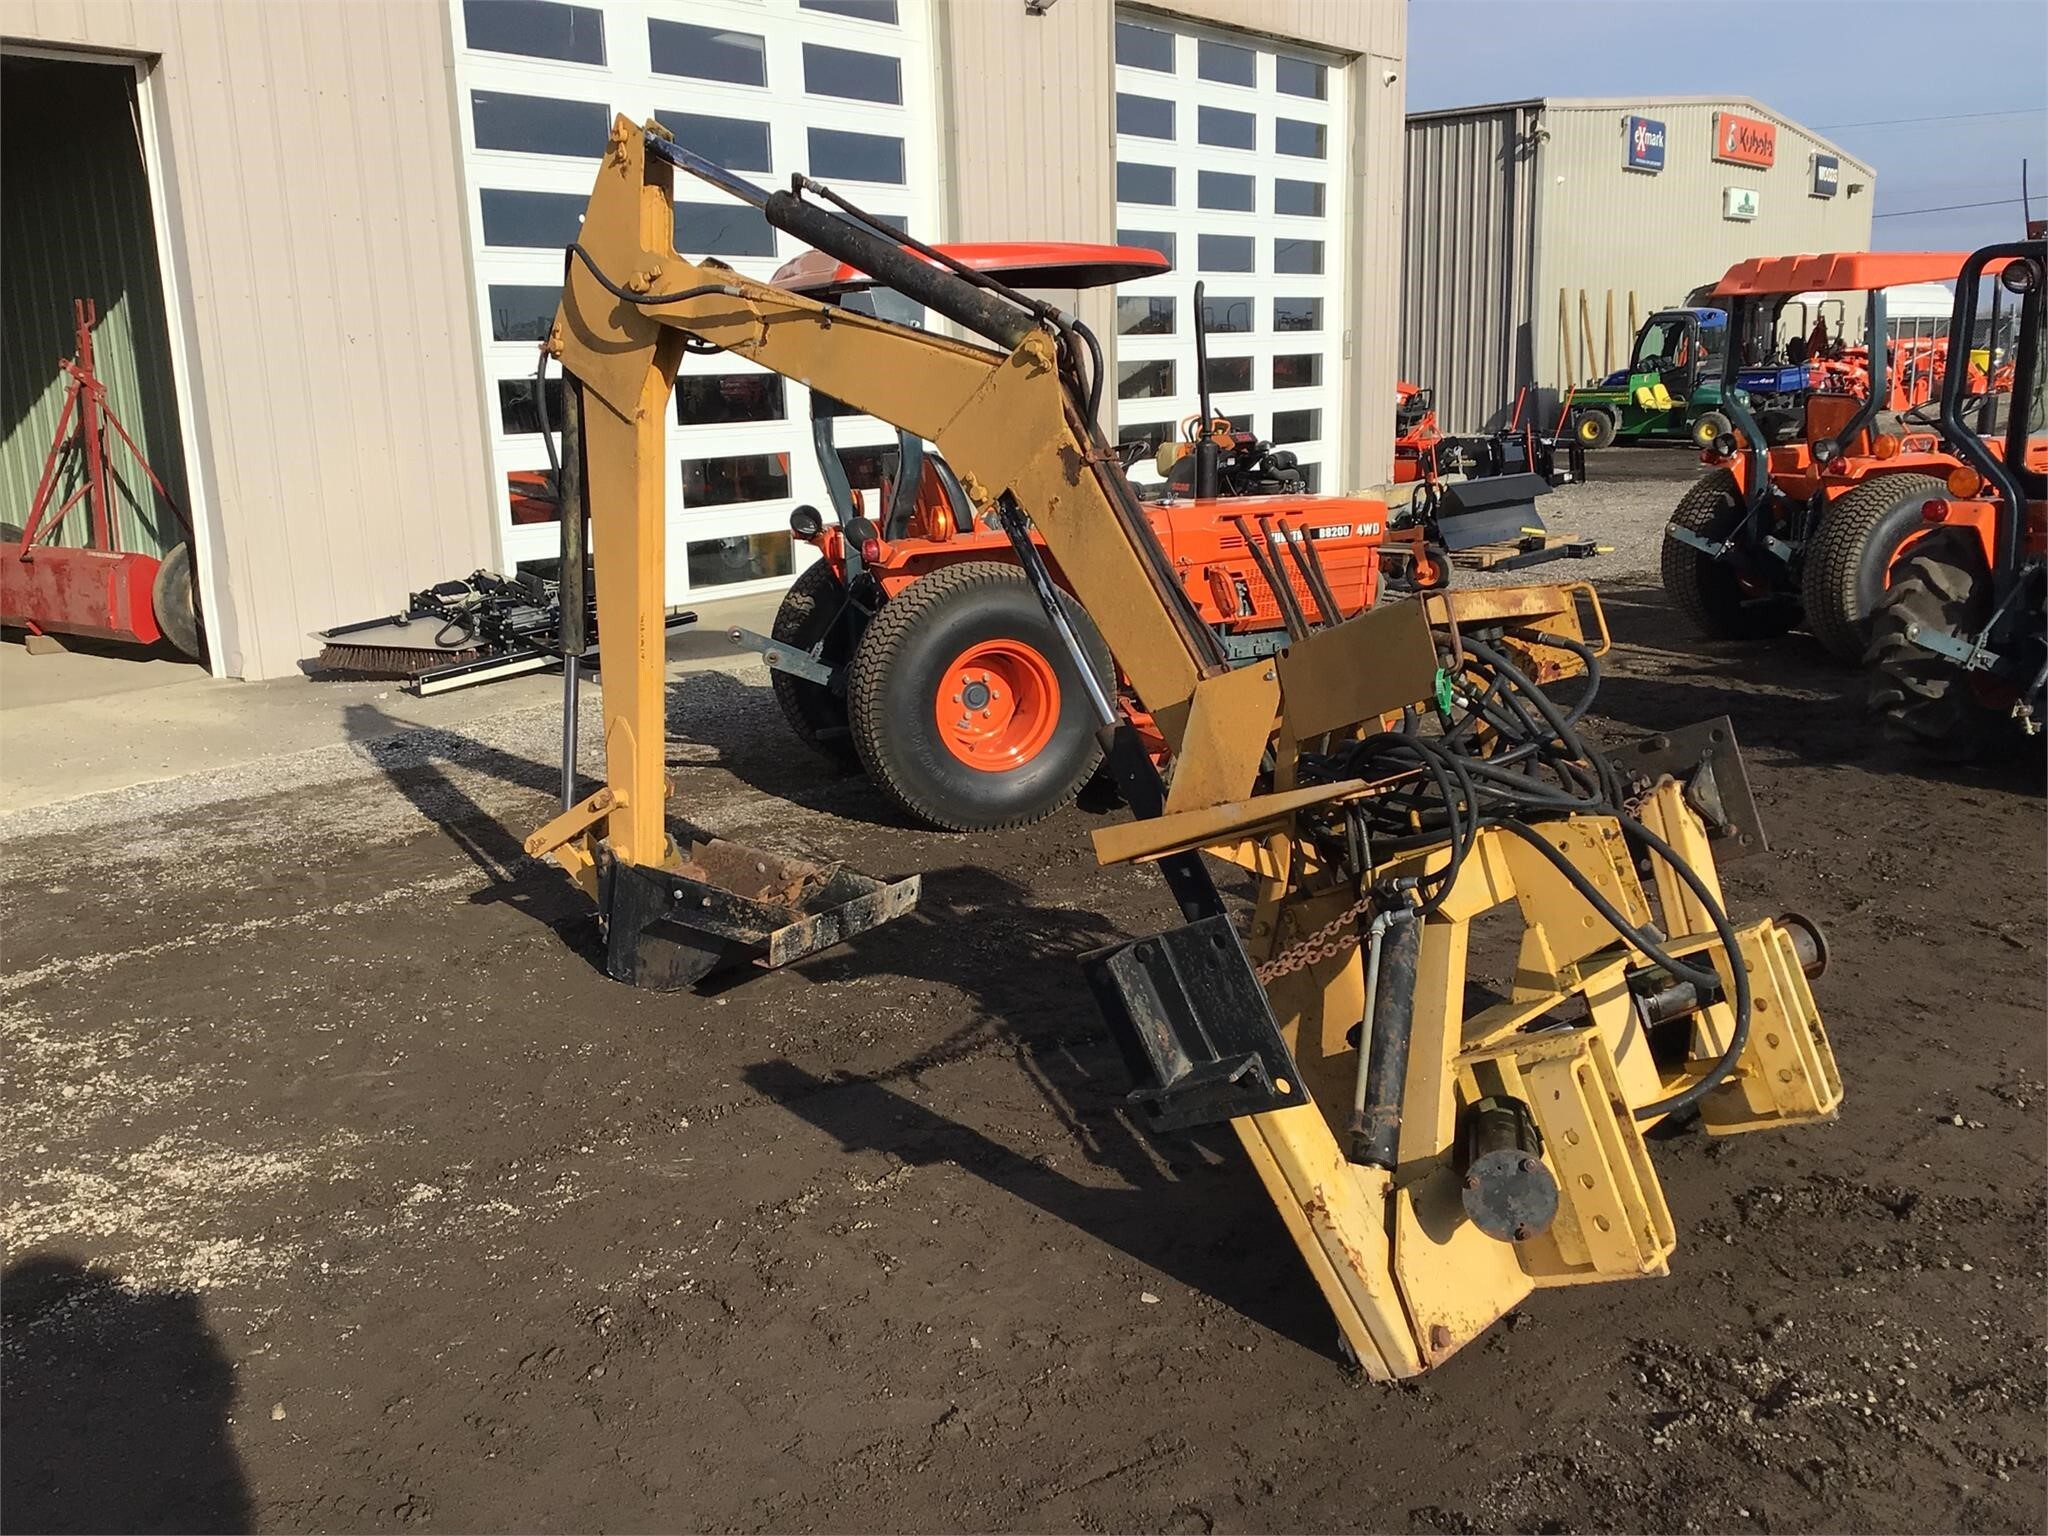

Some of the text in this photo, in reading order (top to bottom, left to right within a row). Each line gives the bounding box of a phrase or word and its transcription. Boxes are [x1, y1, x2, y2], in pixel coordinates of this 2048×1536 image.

[1739, 126, 1774, 157] Kubota
[1318, 525, 1349, 538] B8200
[1356, 523, 1379, 535] 4WD
